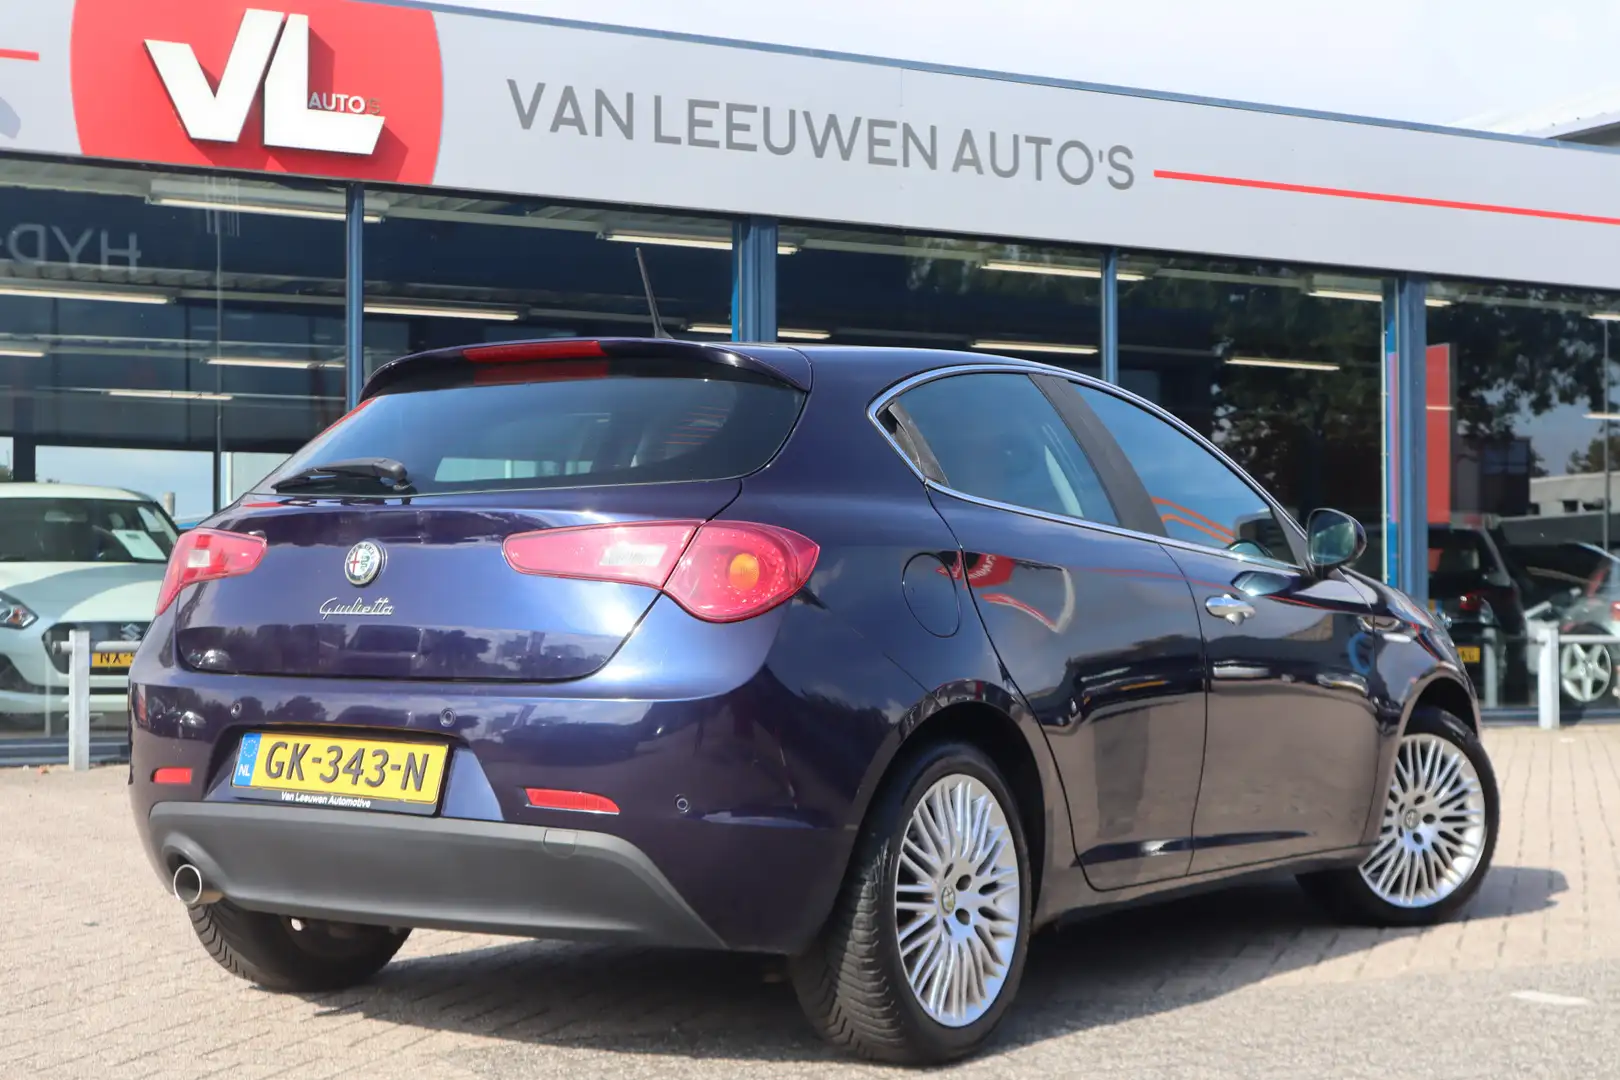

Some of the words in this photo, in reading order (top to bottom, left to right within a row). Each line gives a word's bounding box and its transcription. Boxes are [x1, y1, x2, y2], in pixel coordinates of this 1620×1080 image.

[143, 8, 386, 155] VL
[507, 79, 634, 141] VAN
[653, 95, 938, 171] LEEUWEN
[951, 128, 1135, 190] AUTO'S
[238, 764, 251, 778] NL
[264, 741, 430, 792] GK-343-N
[281, 791, 295, 801] Van
[295, 792, 328, 805] Leeuwen
[328, 795, 372, 808] Automotive
